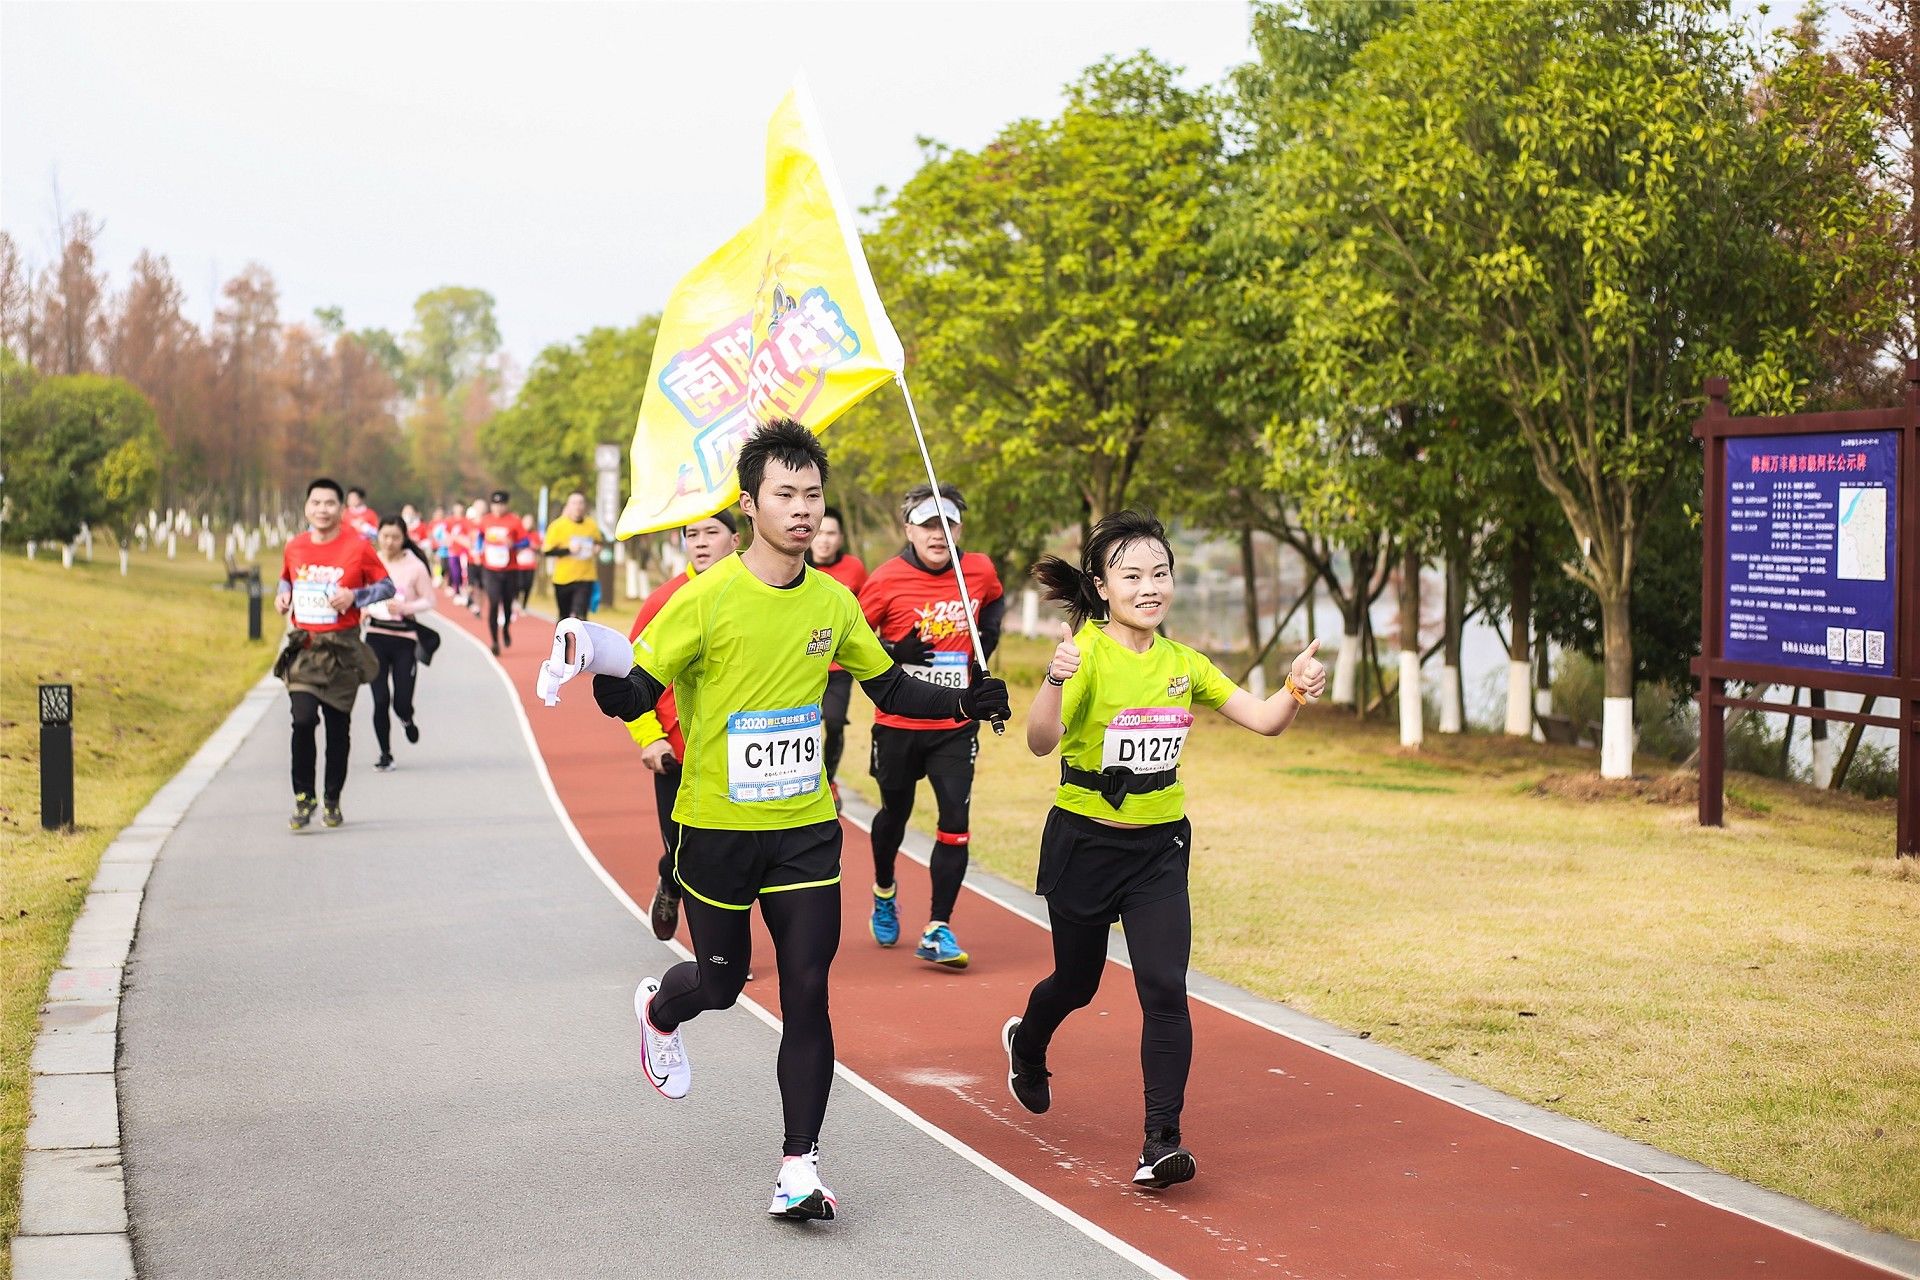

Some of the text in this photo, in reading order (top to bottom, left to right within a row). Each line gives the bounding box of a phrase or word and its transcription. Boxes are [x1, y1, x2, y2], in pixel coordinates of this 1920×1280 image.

[741, 717, 767, 730] 2020
[745, 736, 815, 768] C1719
[1118, 736, 1182, 762] D1275
